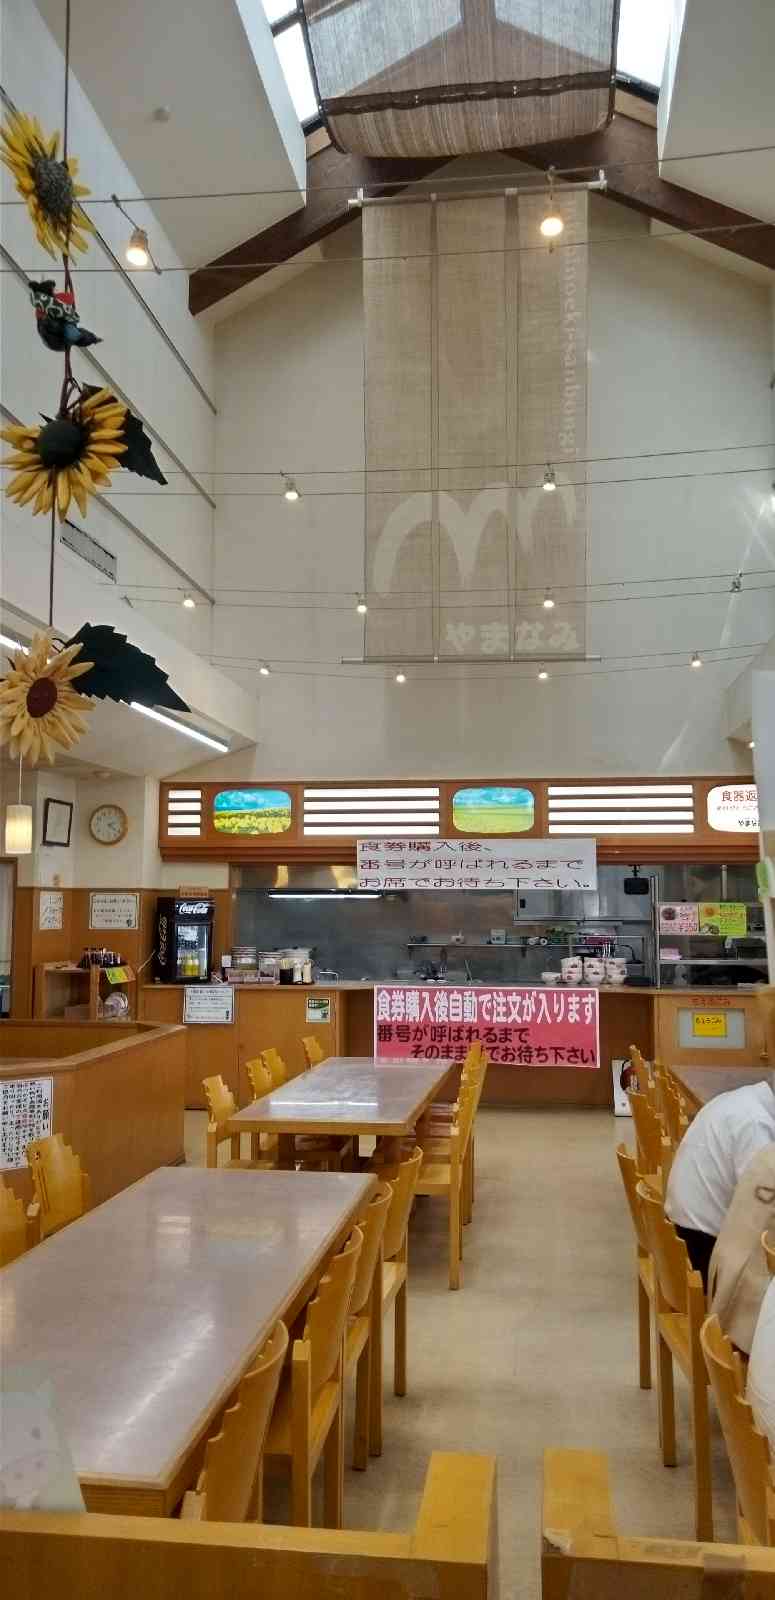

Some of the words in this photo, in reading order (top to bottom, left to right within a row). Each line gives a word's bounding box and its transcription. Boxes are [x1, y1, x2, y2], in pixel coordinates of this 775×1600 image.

[445, 621, 580, 654] やまなみ
[359, 841, 493, 852] 食券購入後、
[359, 859, 585, 870] 番号が呼ばれるまで
[359, 877, 590, 889] お席でお待ち下さい。
[178, 902, 209, 914] Coca-Cola
[377, 990, 595, 1024] 食券購入後自動で注文が入ります
[376, 1025, 530, 1044] 番号が呼ばれるまで
[411, 1045, 595, 1064] そのままでお待ち下さい
